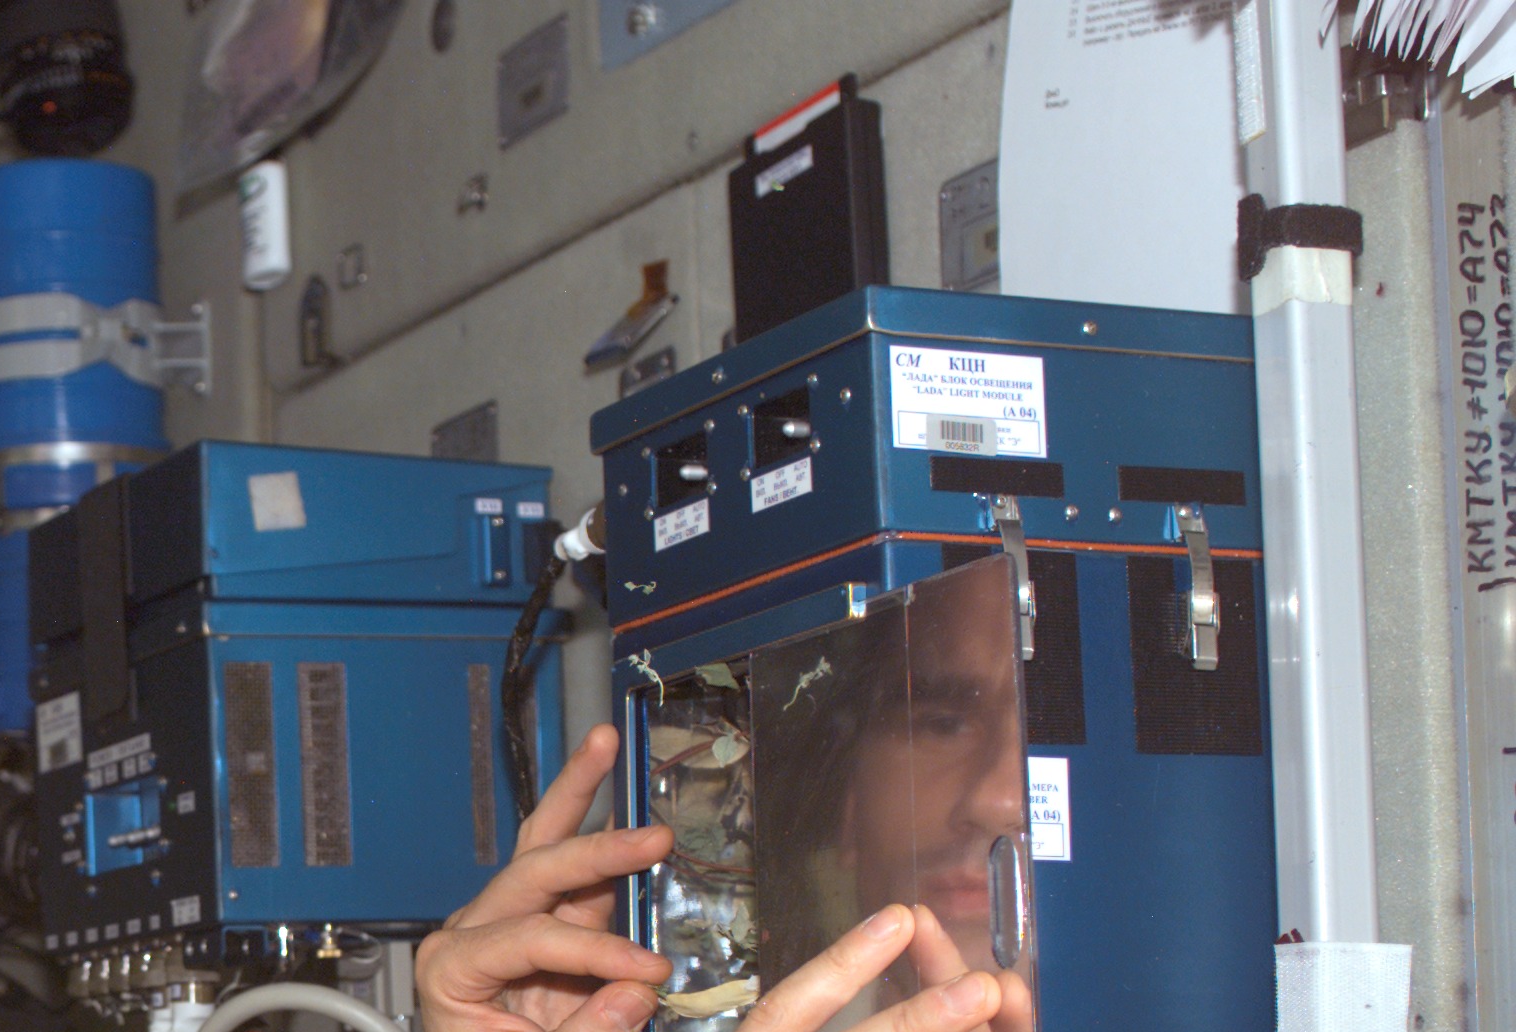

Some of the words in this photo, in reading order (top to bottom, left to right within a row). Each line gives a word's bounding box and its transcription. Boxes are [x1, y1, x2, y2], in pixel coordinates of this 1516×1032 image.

[948, 356, 987, 374] КЦН
[940, 375, 968, 386] БЛОК
[969, 377, 1033, 390] ОСВЕЩЕНИЯ
[949, 388, 980, 399] LIGHT
[982, 391, 1024, 401] MODULE
[1030, 783, 1059, 792] МЕРА
